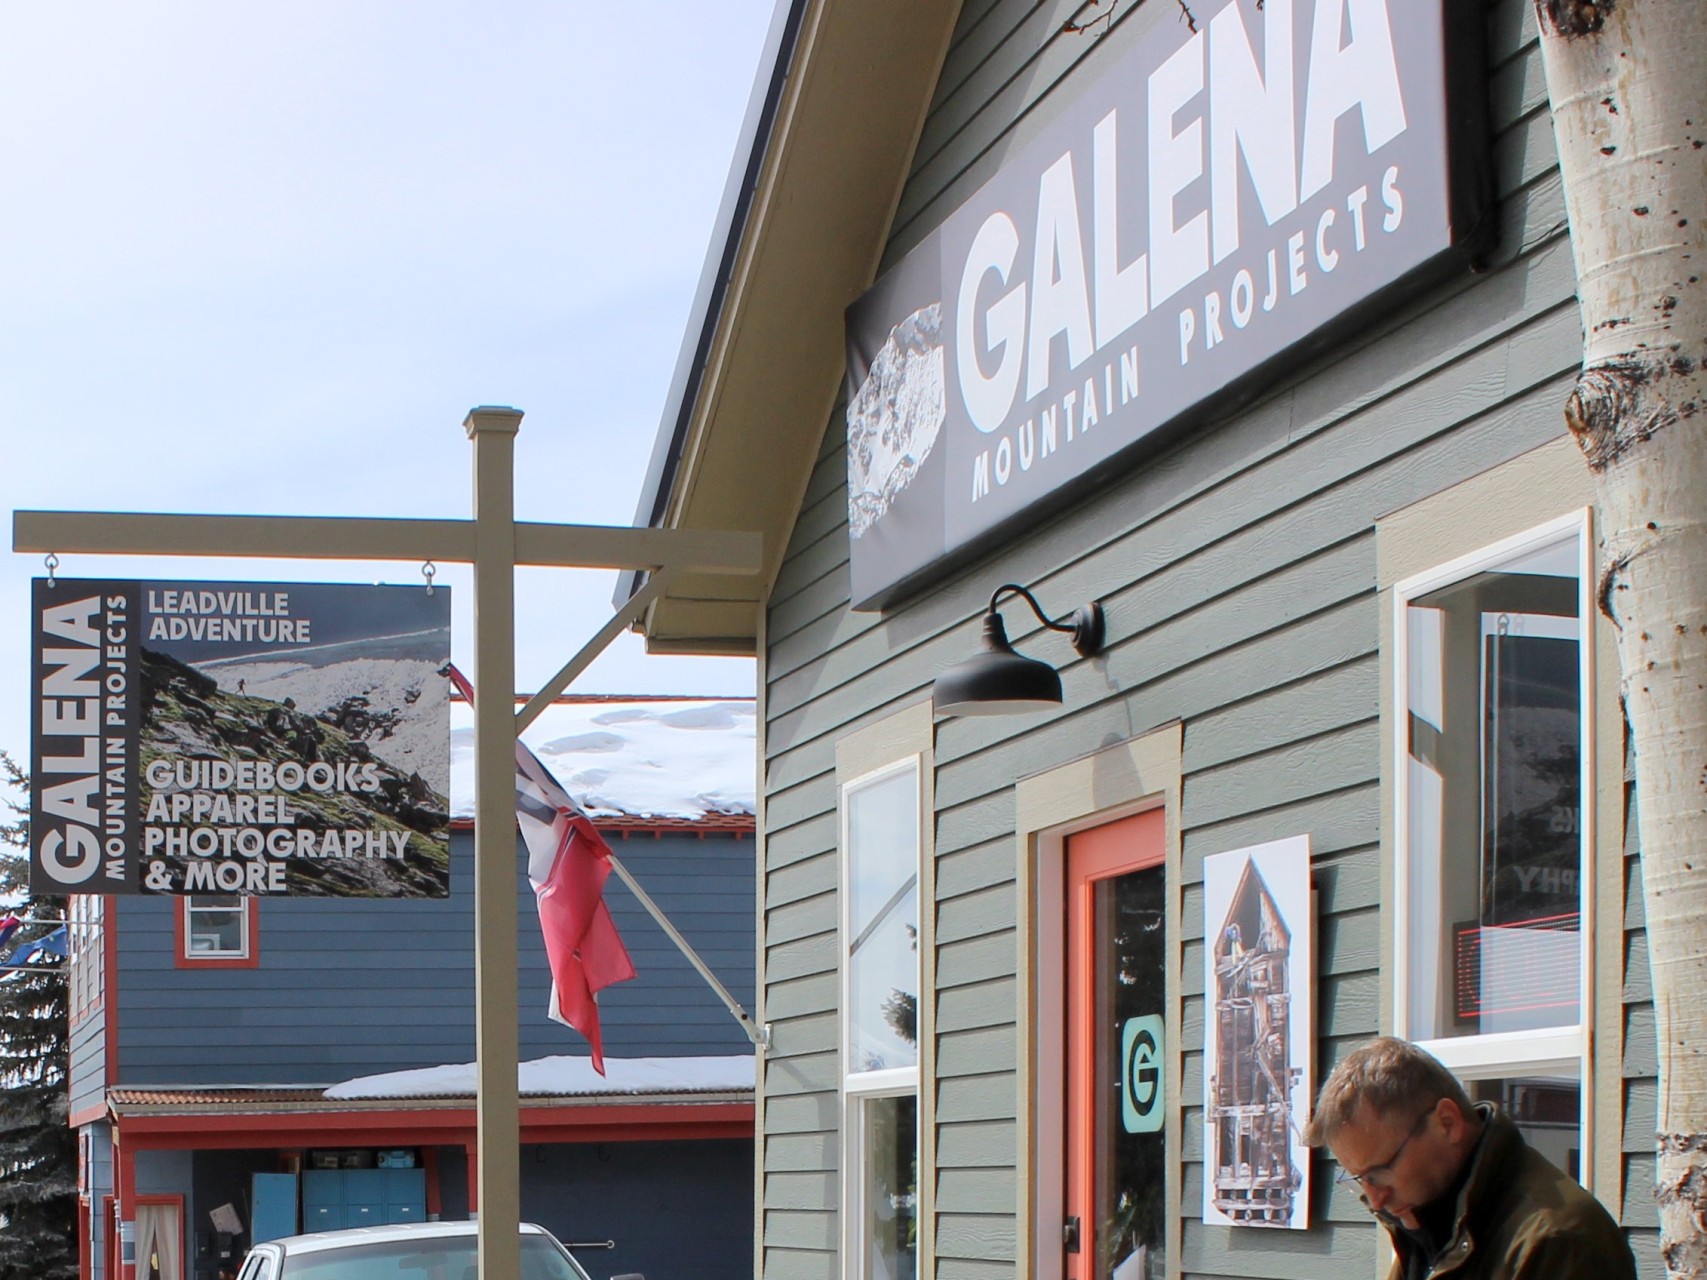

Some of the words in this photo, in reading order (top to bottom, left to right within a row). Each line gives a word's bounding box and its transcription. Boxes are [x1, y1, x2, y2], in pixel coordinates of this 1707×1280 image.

[956, 0, 1408, 434] GALENA
[971, 345, 1140, 503] MOUNTAIN
[1178, 165, 1404, 366] PROJECTS
[148, 590, 289, 616] LEADVILLE
[149, 618, 311, 643] ADVENTURE
[106, 595, 127, 726] PROJECTS
[40, 594, 101, 884] GALENA
[145, 760, 380, 792] GUIDEBOOKS
[105, 737, 126, 881] MOUNTAIN
[145, 794, 295, 824] APPAREL
[145, 828, 412, 859] PHOTOGRAPHY
[145, 861, 172, 891] &
[184, 862, 287, 891] MORE
[1128, 1029, 1159, 1117] G
